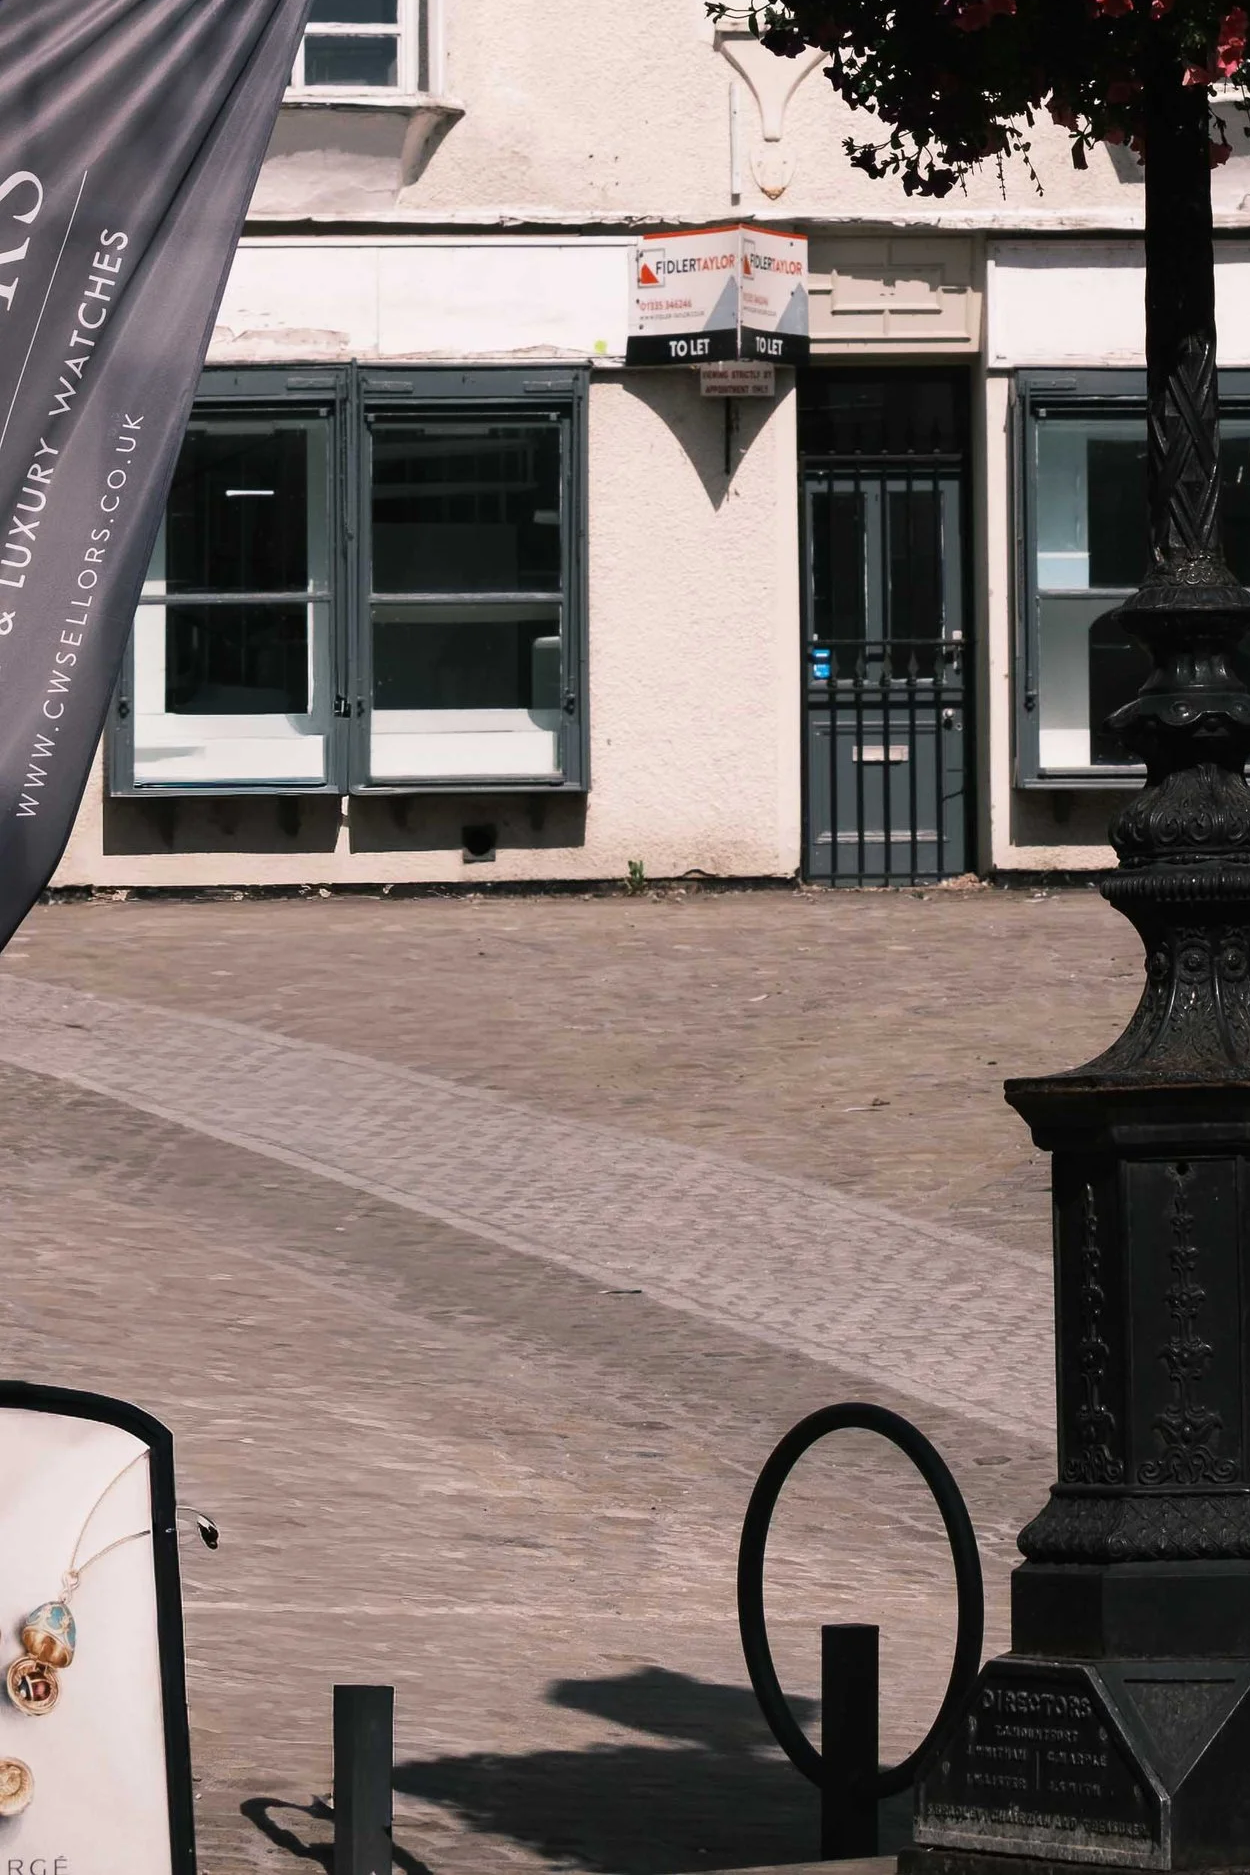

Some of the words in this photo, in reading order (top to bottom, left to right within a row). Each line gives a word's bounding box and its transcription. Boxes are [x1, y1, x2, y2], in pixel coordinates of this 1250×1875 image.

[656, 254, 735, 274] FIDLERTAYLOR
[750, 253, 803, 276] FIDLERTAYLOR
[669, 340, 688, 357] TO
[690, 338, 710, 356] LET
[755, 336, 766, 353] TO
[768, 338, 783, 355] LET
[705, 385, 748, 393] APPOINTMENT
[0, 437, 59, 589] LUXURY
[49, 228, 129, 417] WATCHES
[15, 413, 145, 817] WWW.CWSELLORS.CO.UK
[982, 1688, 1092, 1718] DIRECTORS
